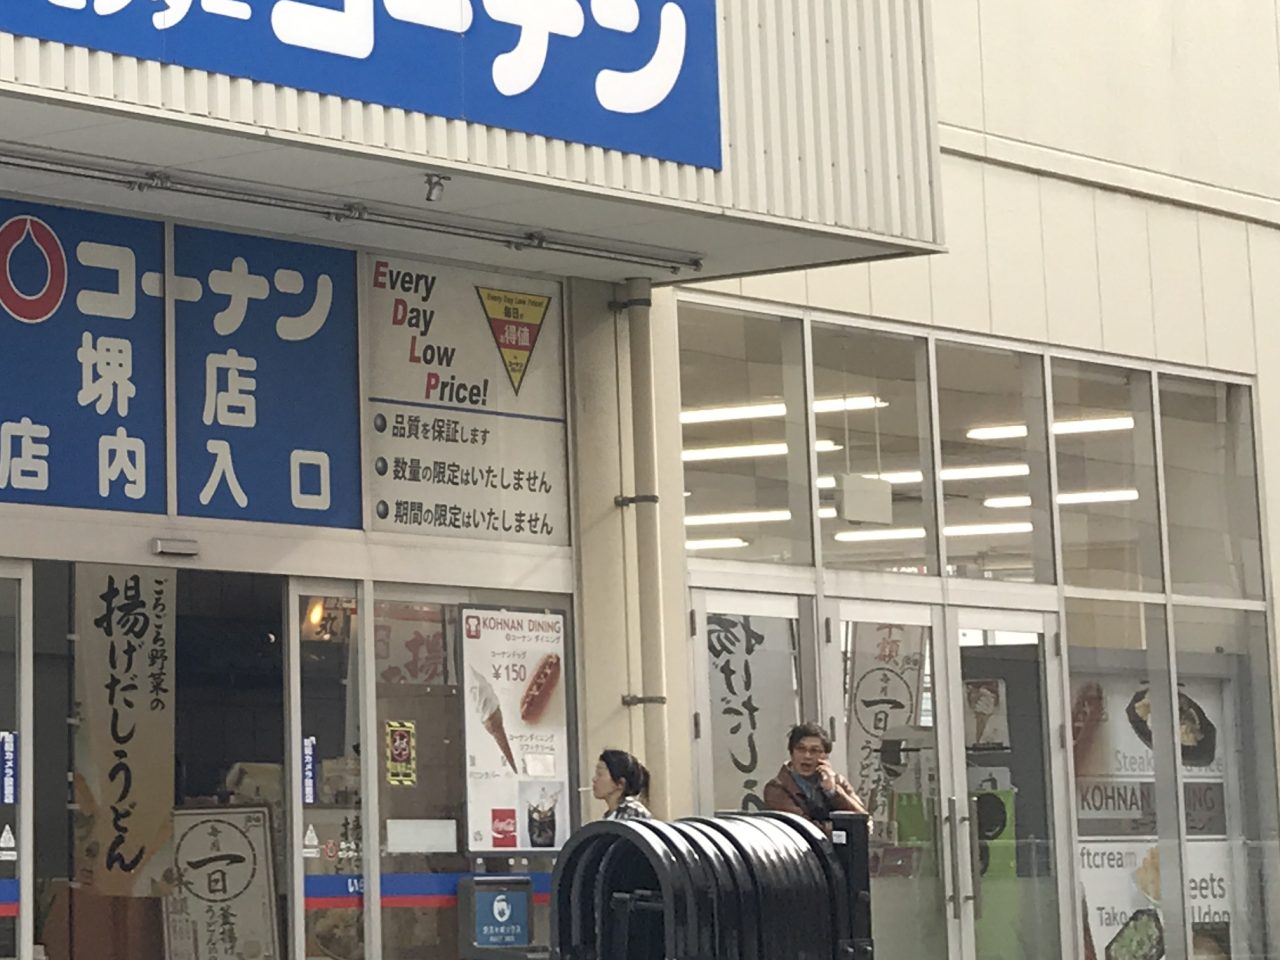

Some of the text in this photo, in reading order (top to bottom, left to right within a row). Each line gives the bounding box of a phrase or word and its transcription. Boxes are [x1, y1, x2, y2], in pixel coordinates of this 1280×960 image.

[76, 241, 333, 341] コーナン
[372, 260, 436, 302] Every
[392, 298, 435, 336] Day
[409, 336, 456, 367] Low
[425, 372, 489, 406] Price!
[392, 414, 490, 446] 品質を保証します
[393, 457, 552, 494] 数量の限定はいたしません
[394, 499, 554, 535] 期間の限定はいたしません
[482, 617, 560, 633] KOHNAN DINING
[147, 578, 169, 711] ごろごろ野菜の
[492, 664, 526, 681] ¥150
[94, 574, 150, 872] 揚げだしうどん
[1080, 785, 1151, 811] KOHNAN
